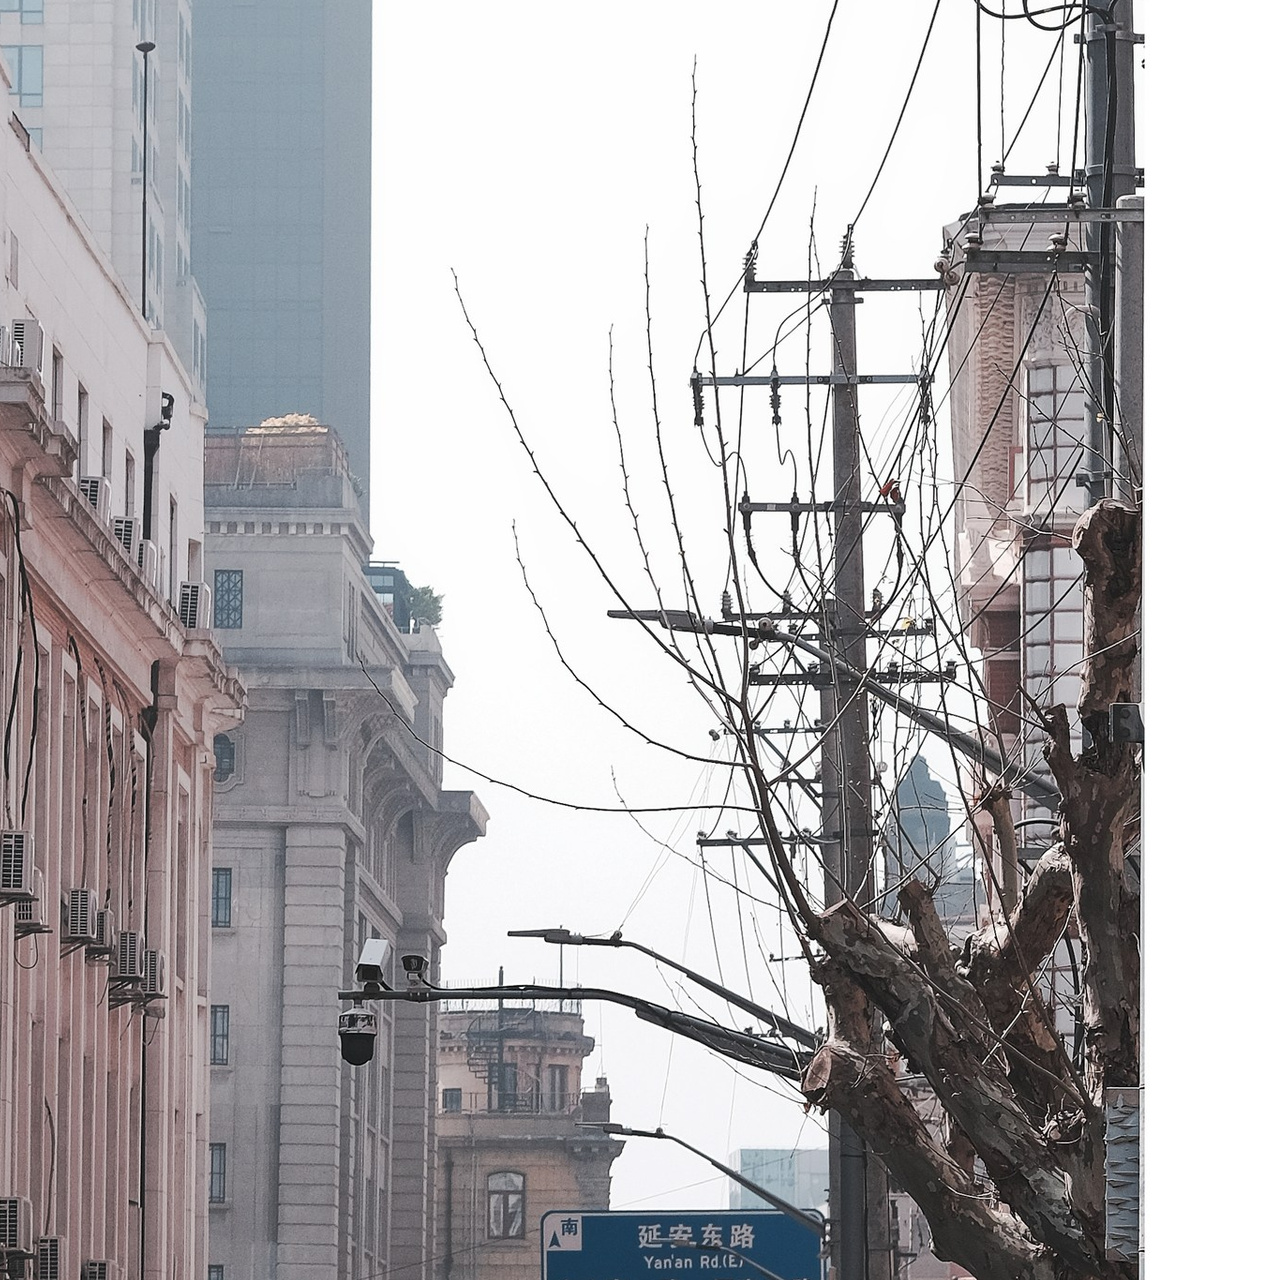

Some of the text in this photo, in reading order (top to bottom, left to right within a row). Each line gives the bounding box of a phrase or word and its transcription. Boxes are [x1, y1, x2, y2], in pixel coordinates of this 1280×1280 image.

[560, 1218, 578, 1236] 南
[638, 1224, 756, 1249] 延安东路
[644, 1255, 744, 1270] Yan'an Rd.(E)
